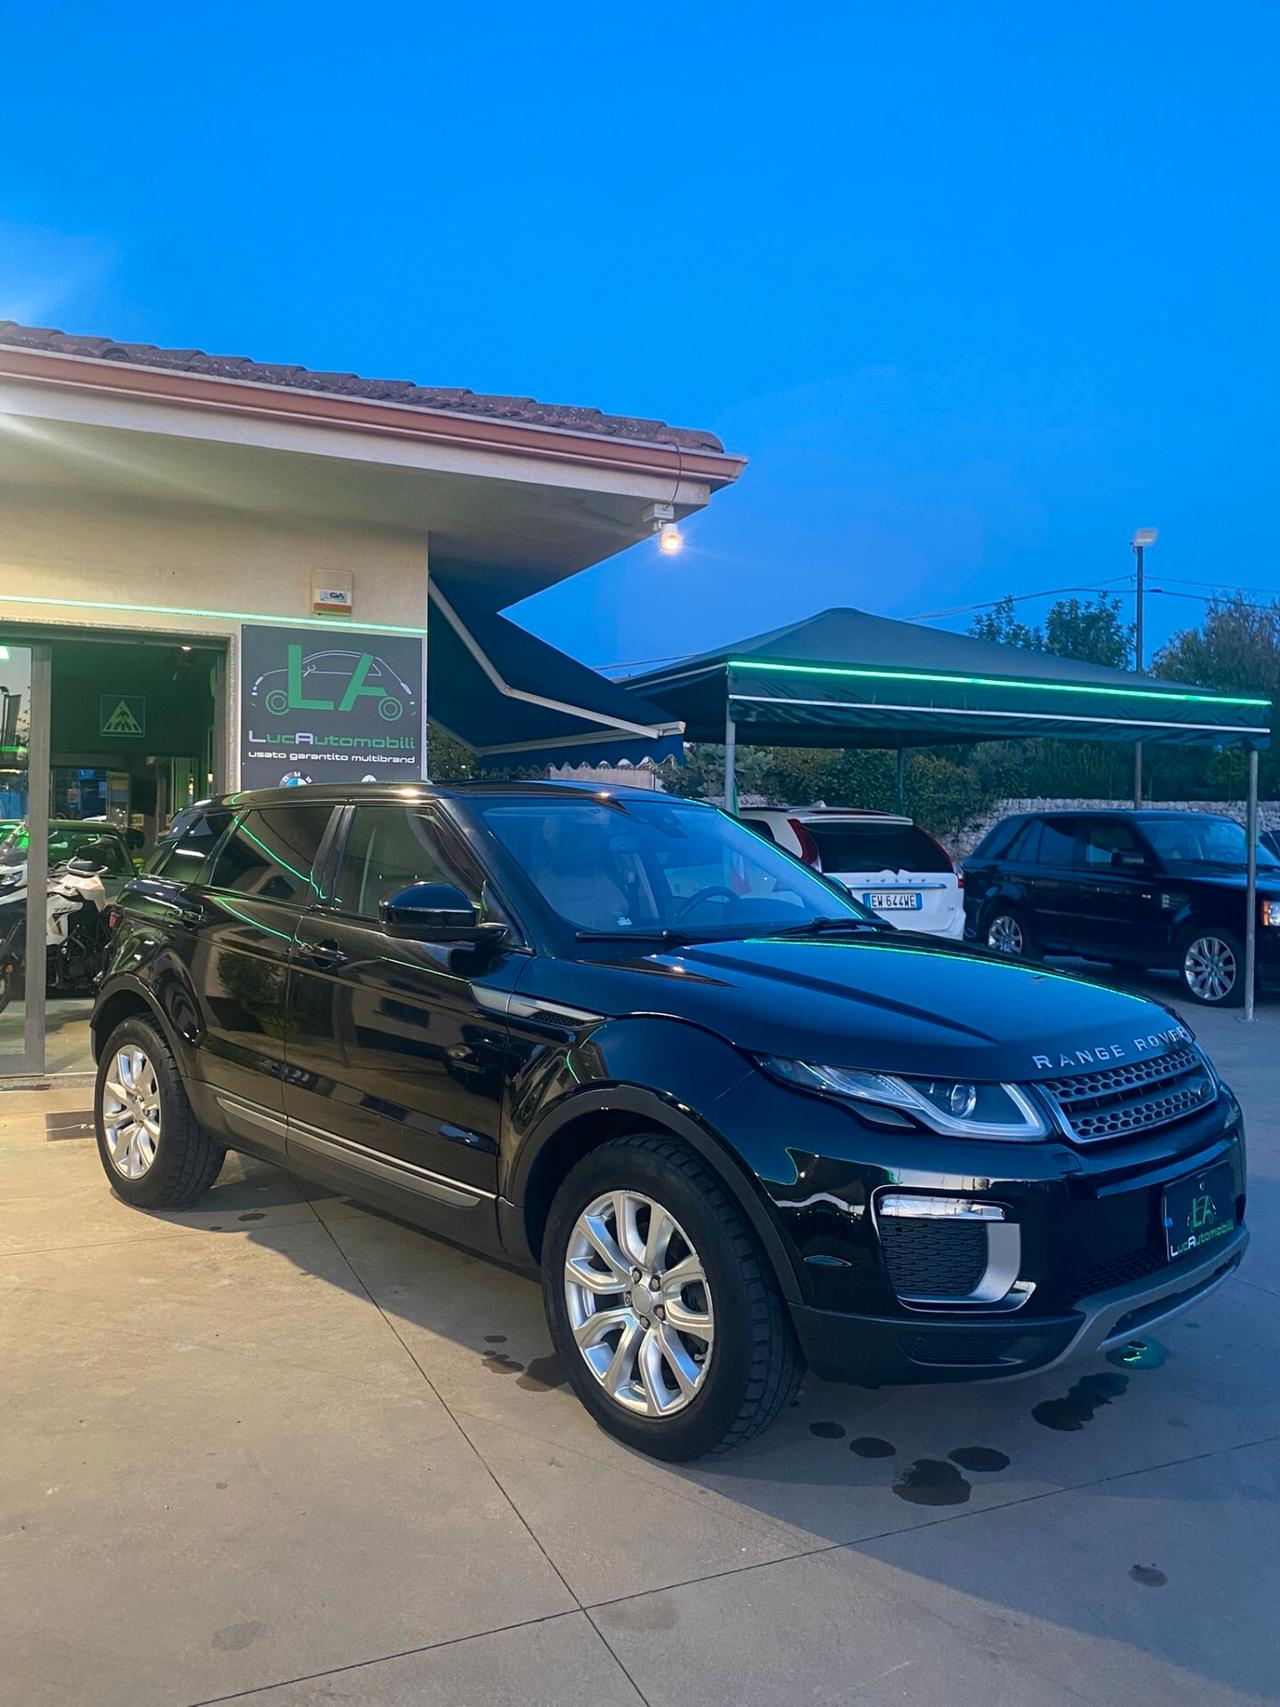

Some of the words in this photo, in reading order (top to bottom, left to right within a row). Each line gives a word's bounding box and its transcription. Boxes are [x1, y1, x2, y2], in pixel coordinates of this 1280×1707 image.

[248, 730, 415, 750] LucAutomobili
[248, 751, 287, 759] usato
[289, 752, 349, 761] garantito
[351, 754, 416, 764] multibrand
[1032, 1044, 1126, 1070] RANGE
[1133, 1026, 1191, 1052] ROVER
